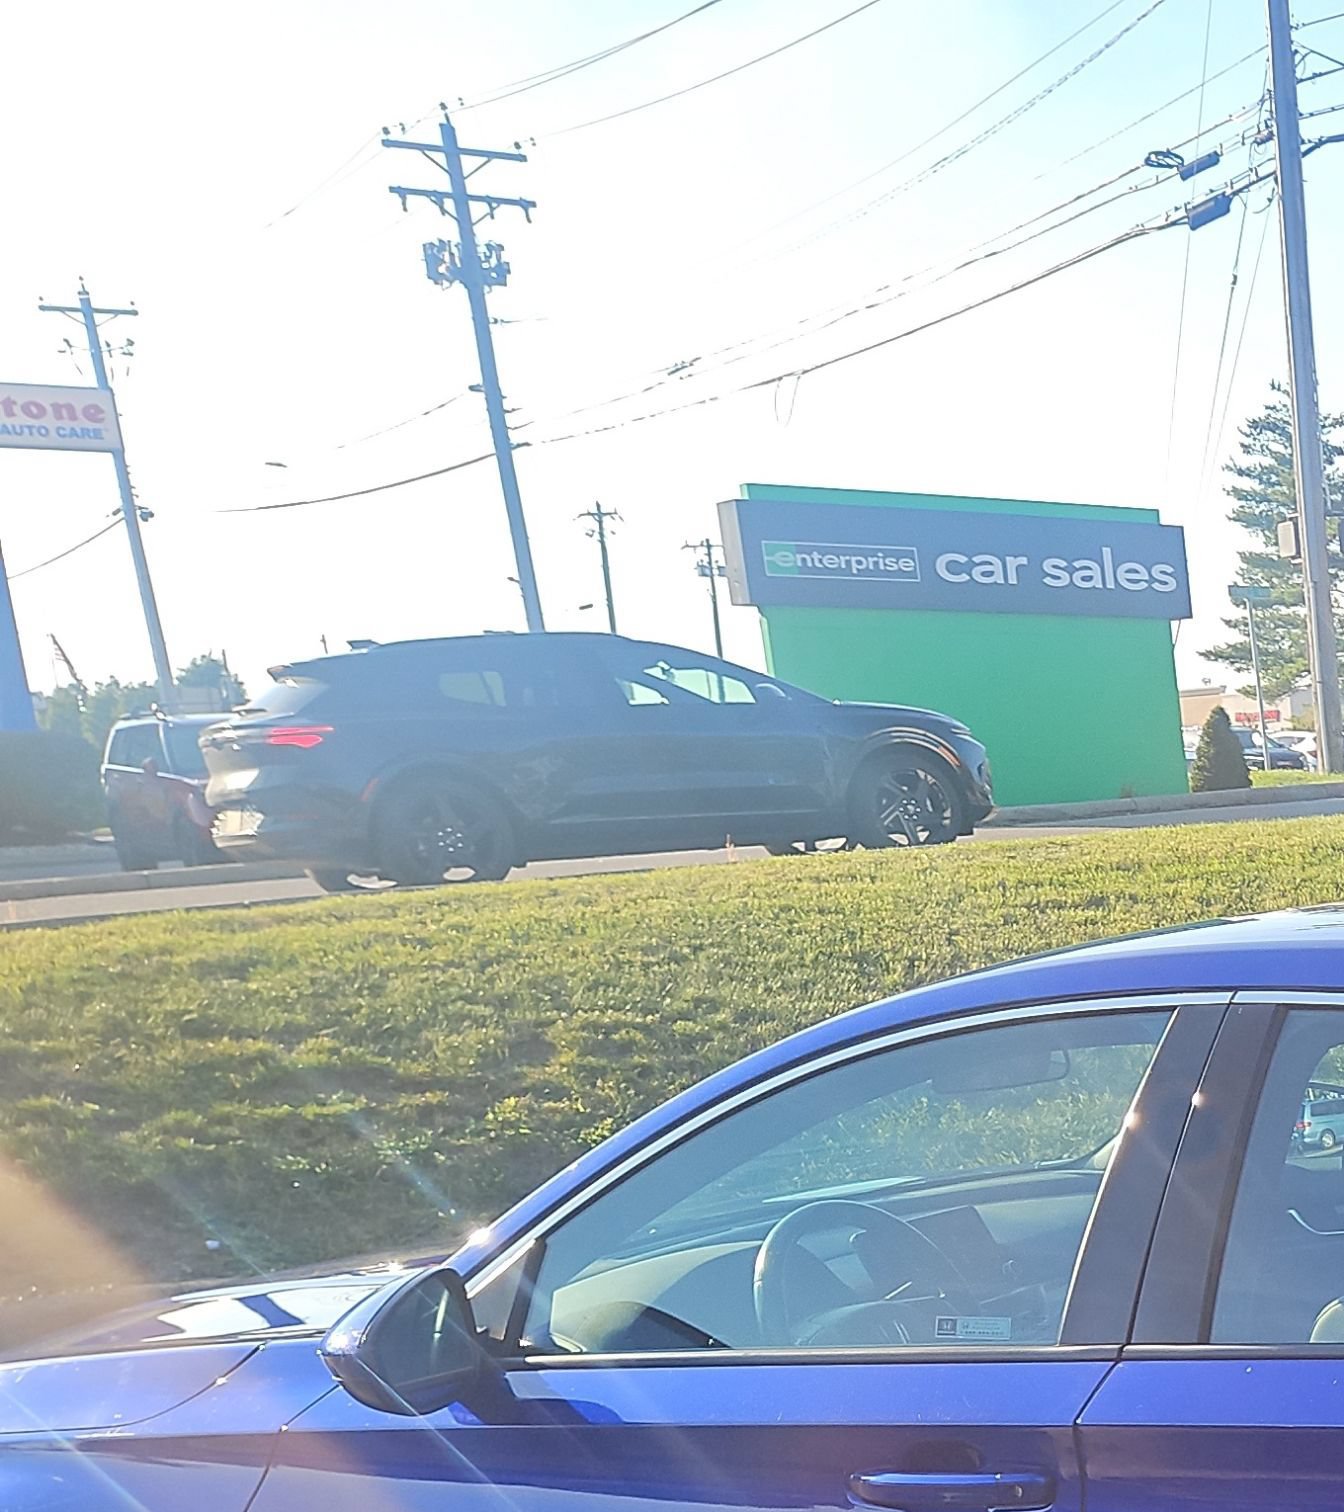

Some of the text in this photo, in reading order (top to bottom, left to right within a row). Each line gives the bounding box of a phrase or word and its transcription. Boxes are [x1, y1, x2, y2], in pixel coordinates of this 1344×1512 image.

[0, 423, 104, 440] AUTO CARE
[765, 547, 1177, 592] enterprise car sales
